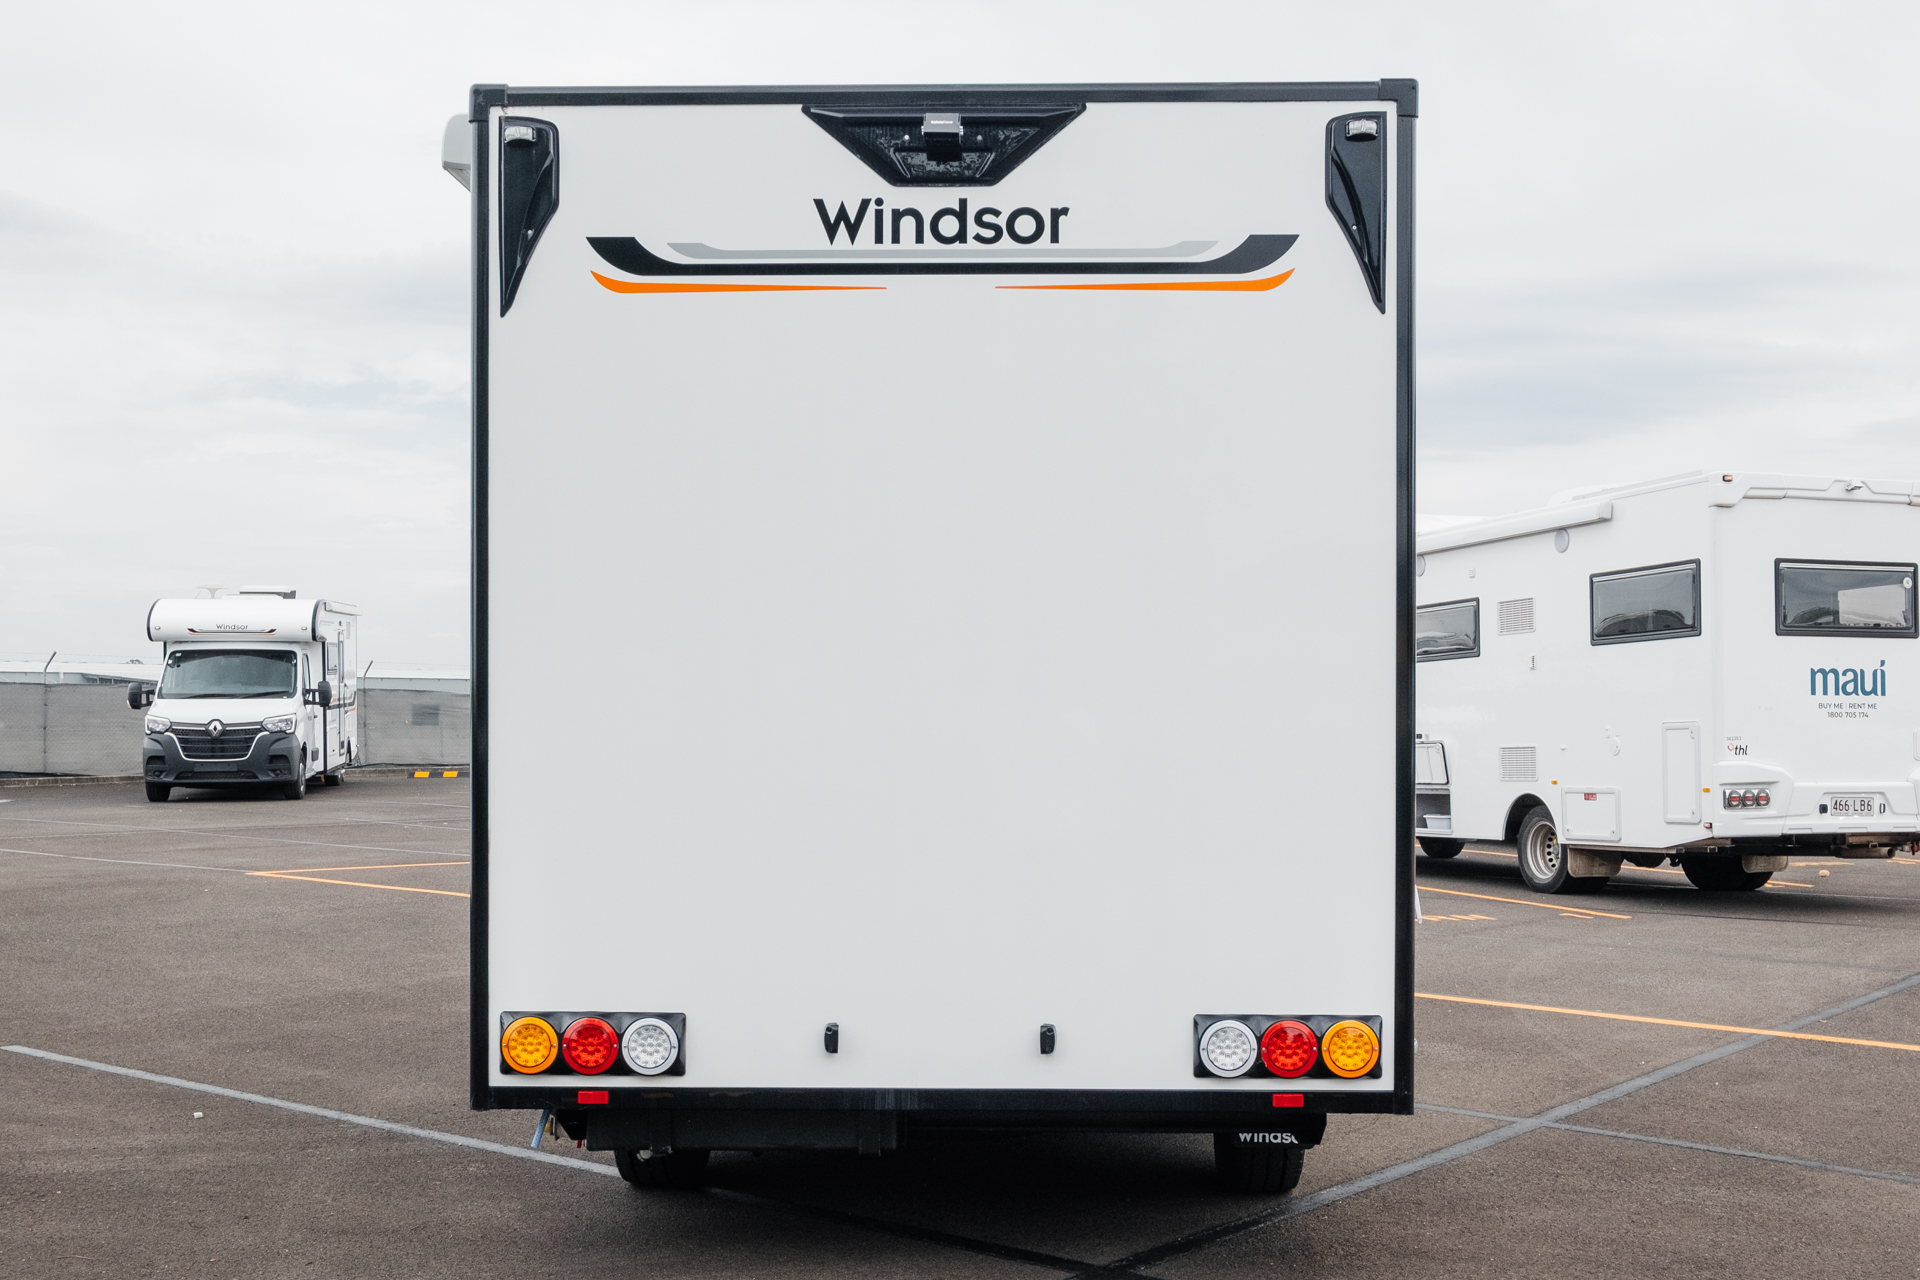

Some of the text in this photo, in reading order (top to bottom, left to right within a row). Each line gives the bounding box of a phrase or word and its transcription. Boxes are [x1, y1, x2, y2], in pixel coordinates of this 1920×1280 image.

[812, 197, 1070, 247] Windsor
[1818, 702, 1832, 710] BUY
[1833, 702, 1844, 710] ME
[1848, 702, 1866, 710] RENT
[1827, 711, 1869, 719] 1800 705 174
[1734, 744, 1748, 756] thl
